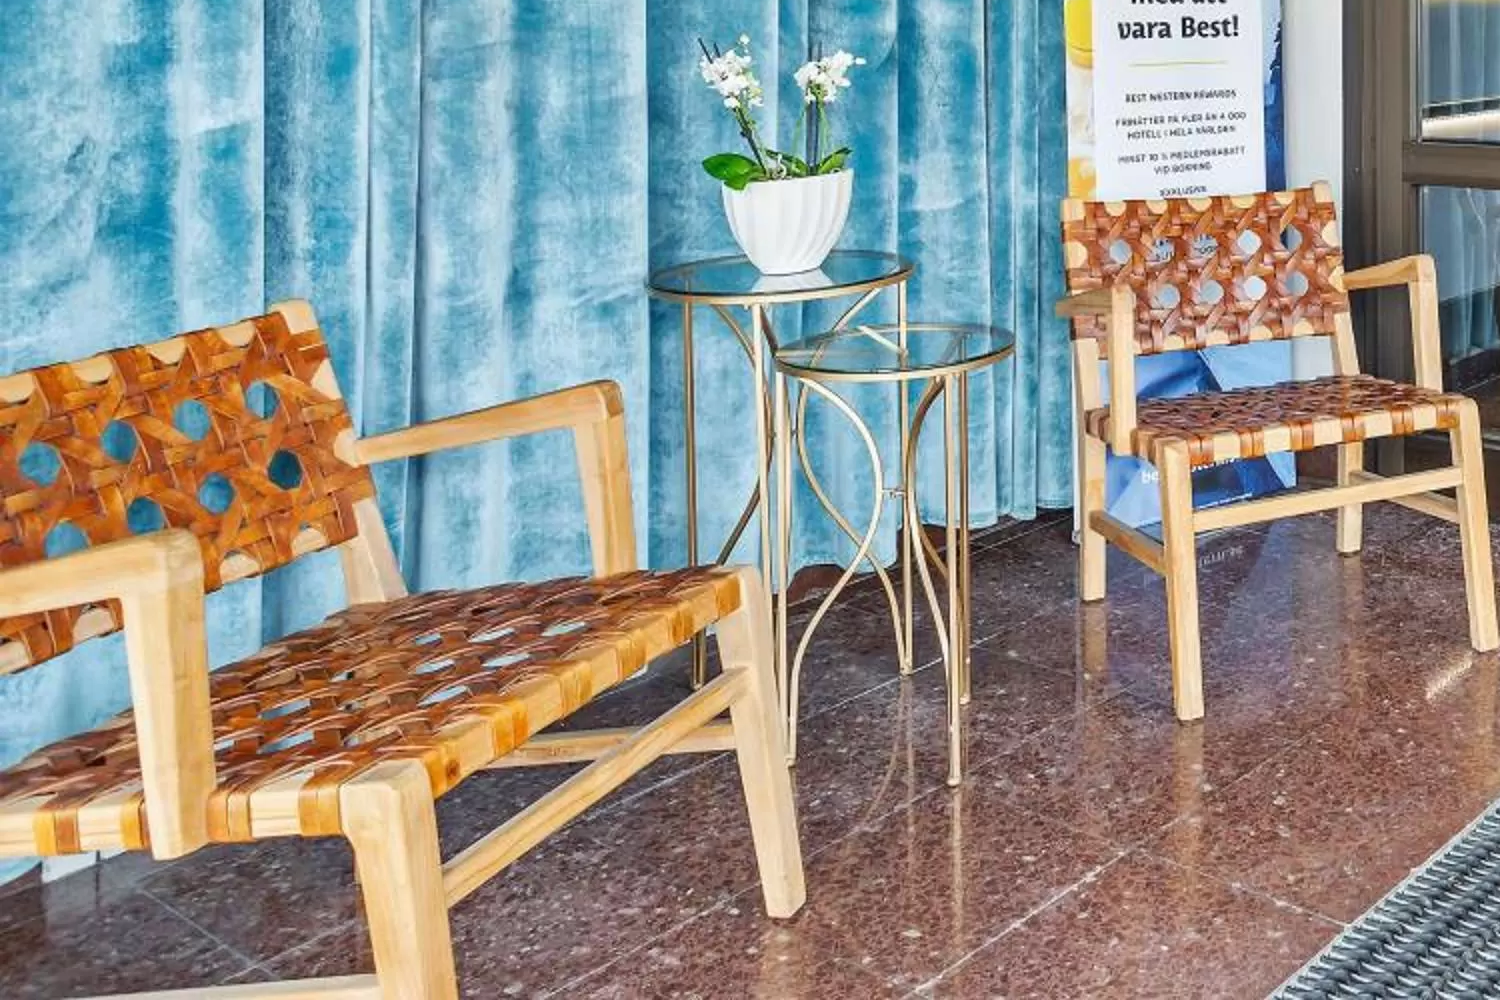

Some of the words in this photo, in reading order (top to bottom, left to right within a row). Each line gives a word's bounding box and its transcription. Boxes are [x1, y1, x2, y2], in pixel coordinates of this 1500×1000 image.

[1118, 21, 1172, 39] vara
[1181, 14, 1239, 39] Best!
[1125, 93, 1147, 103] BEST
[1149, 91, 1191, 102] WESTERN
[1193, 89, 1237, 100] REWARDS
[1127, 129, 1162, 140] HOTELL
[1169, 126, 1193, 137] HELA
